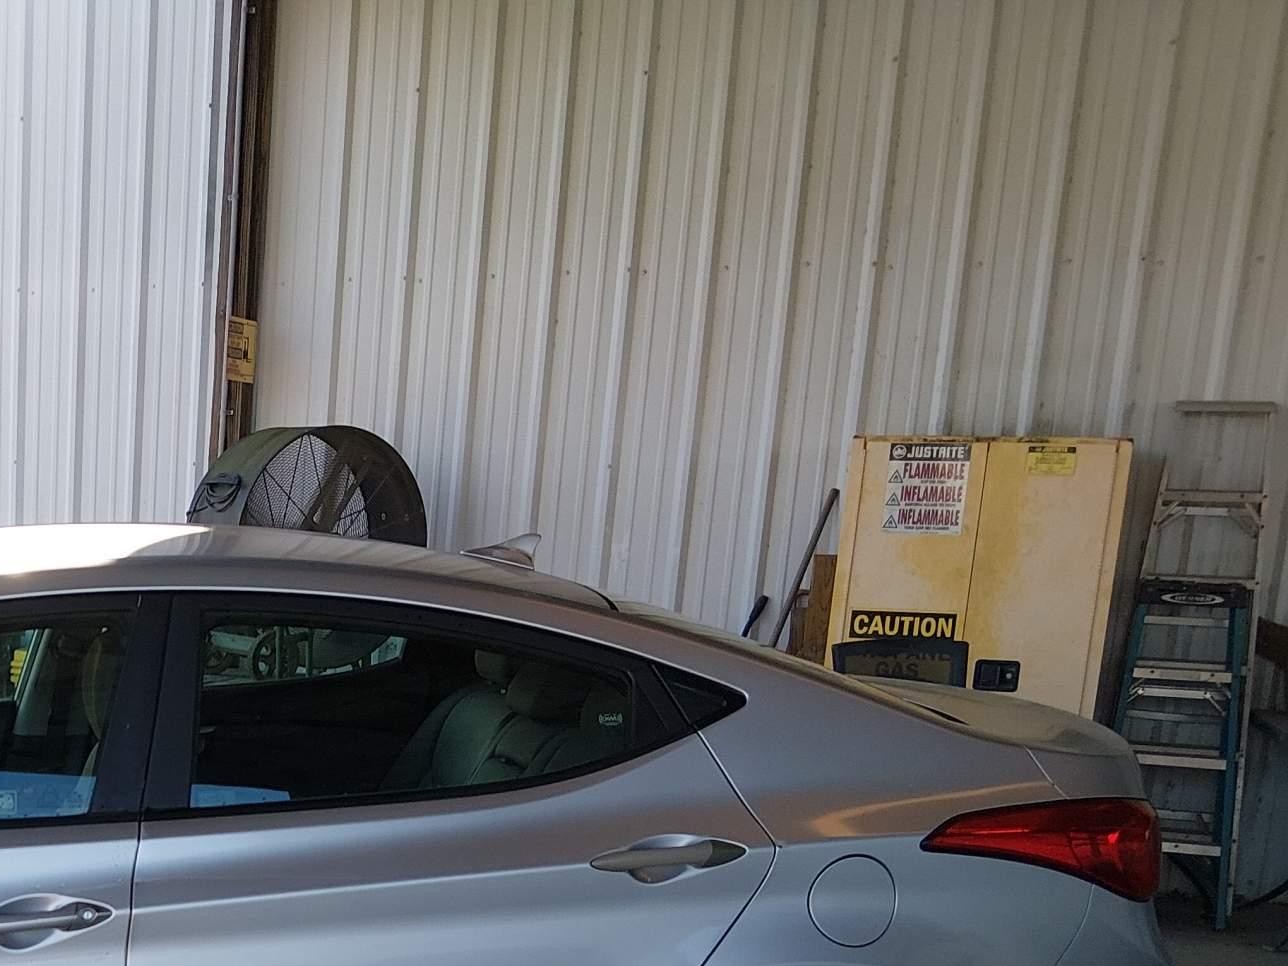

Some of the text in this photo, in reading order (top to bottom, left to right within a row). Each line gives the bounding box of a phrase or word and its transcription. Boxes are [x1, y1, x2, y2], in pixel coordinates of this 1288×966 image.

[907, 446, 965, 459] JUSTRITE
[903, 463, 966, 480] FLAMMABLE
[900, 485, 964, 503] INFLAMABLE
[897, 508, 961, 526] INFLAMMABLE
[853, 614, 954, 638] CAUTION
